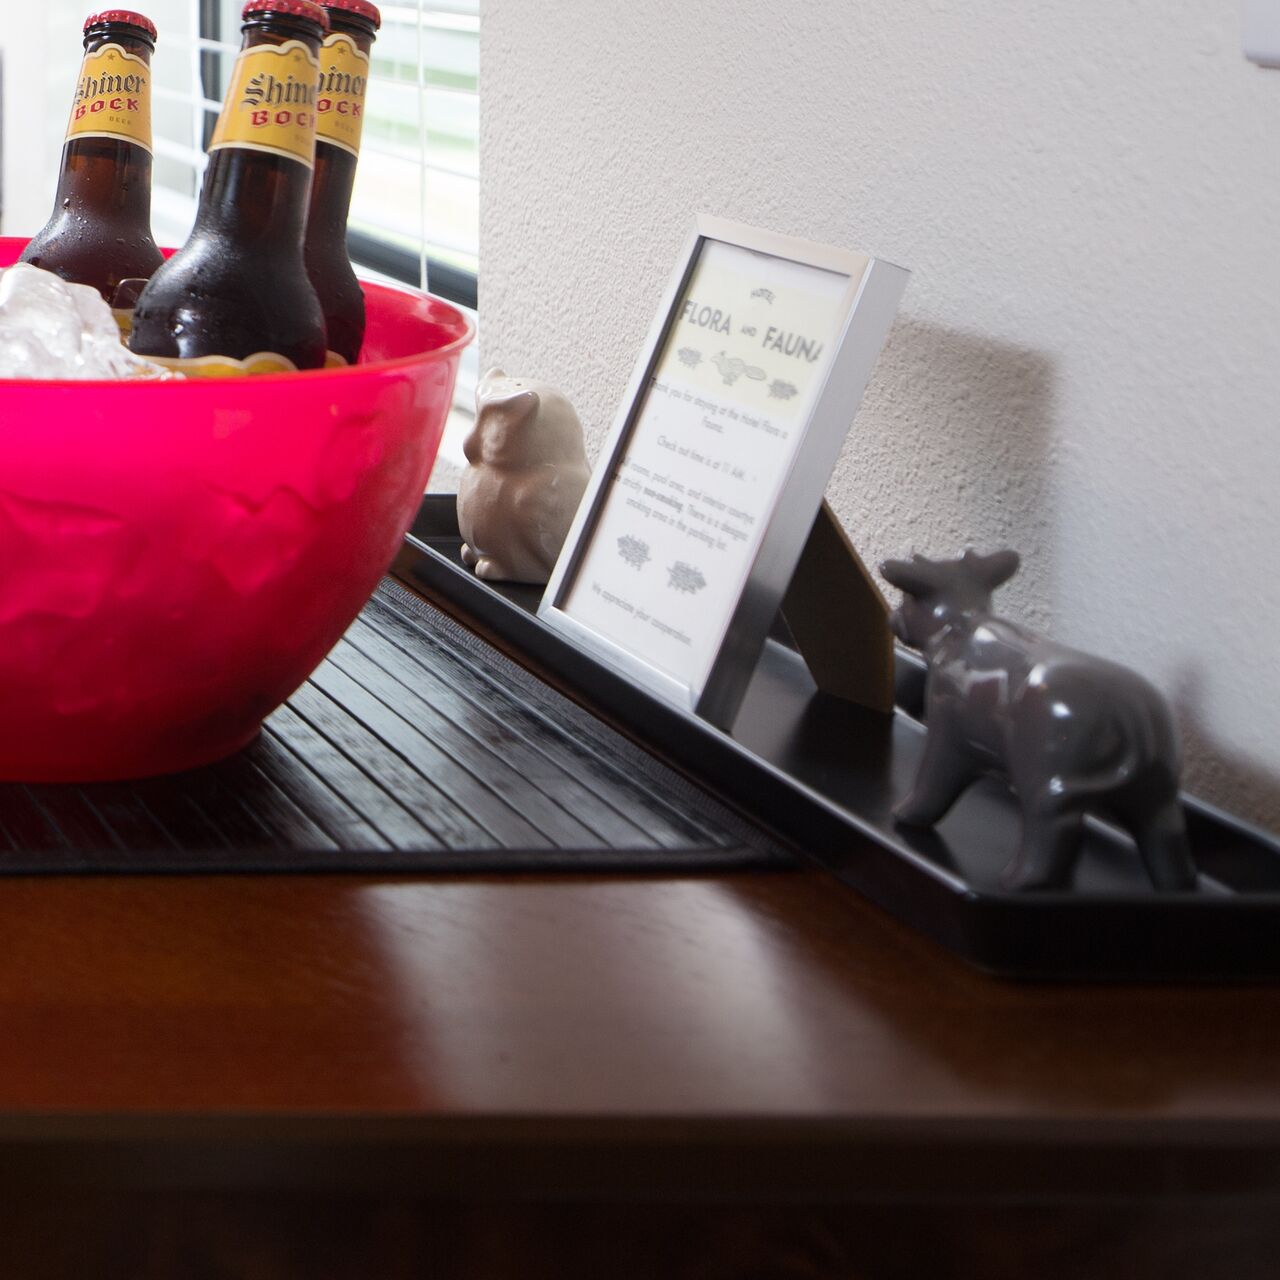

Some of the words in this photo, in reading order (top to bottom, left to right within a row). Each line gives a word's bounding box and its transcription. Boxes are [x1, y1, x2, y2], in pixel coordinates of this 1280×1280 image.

[75, 98, 139, 120] BOCK
[317, 99, 362, 116] OCK
[680, 300, 732, 336] FLORA
